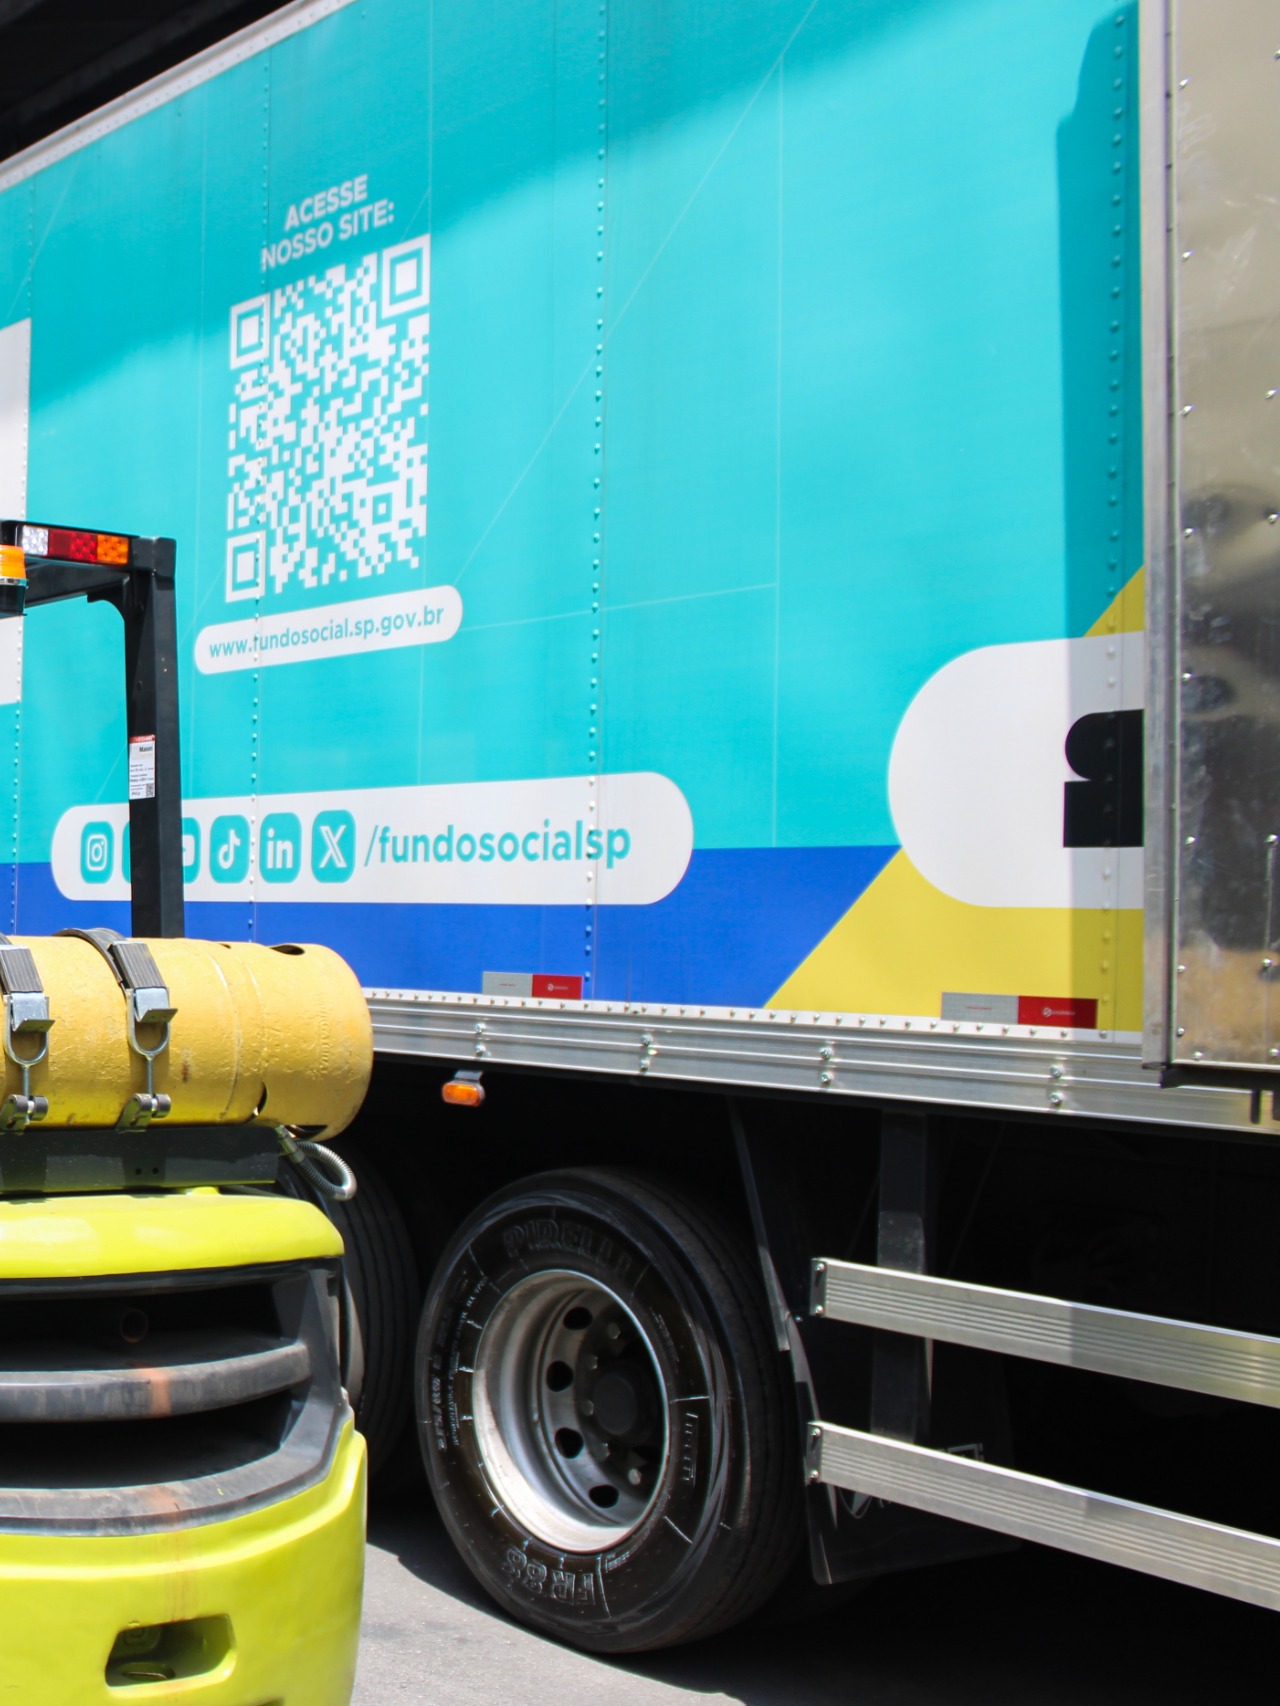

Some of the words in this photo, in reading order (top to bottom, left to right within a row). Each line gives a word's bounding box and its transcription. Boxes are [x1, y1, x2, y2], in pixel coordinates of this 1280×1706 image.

[284, 174, 368, 231] ACESSE
[262, 222, 334, 271] NOSSO
[338, 199, 395, 240] SITE:
[209, 605, 444, 658] www.fundosocial.sp.gov.br
[364, 818, 631, 869] /fundosocialsp
